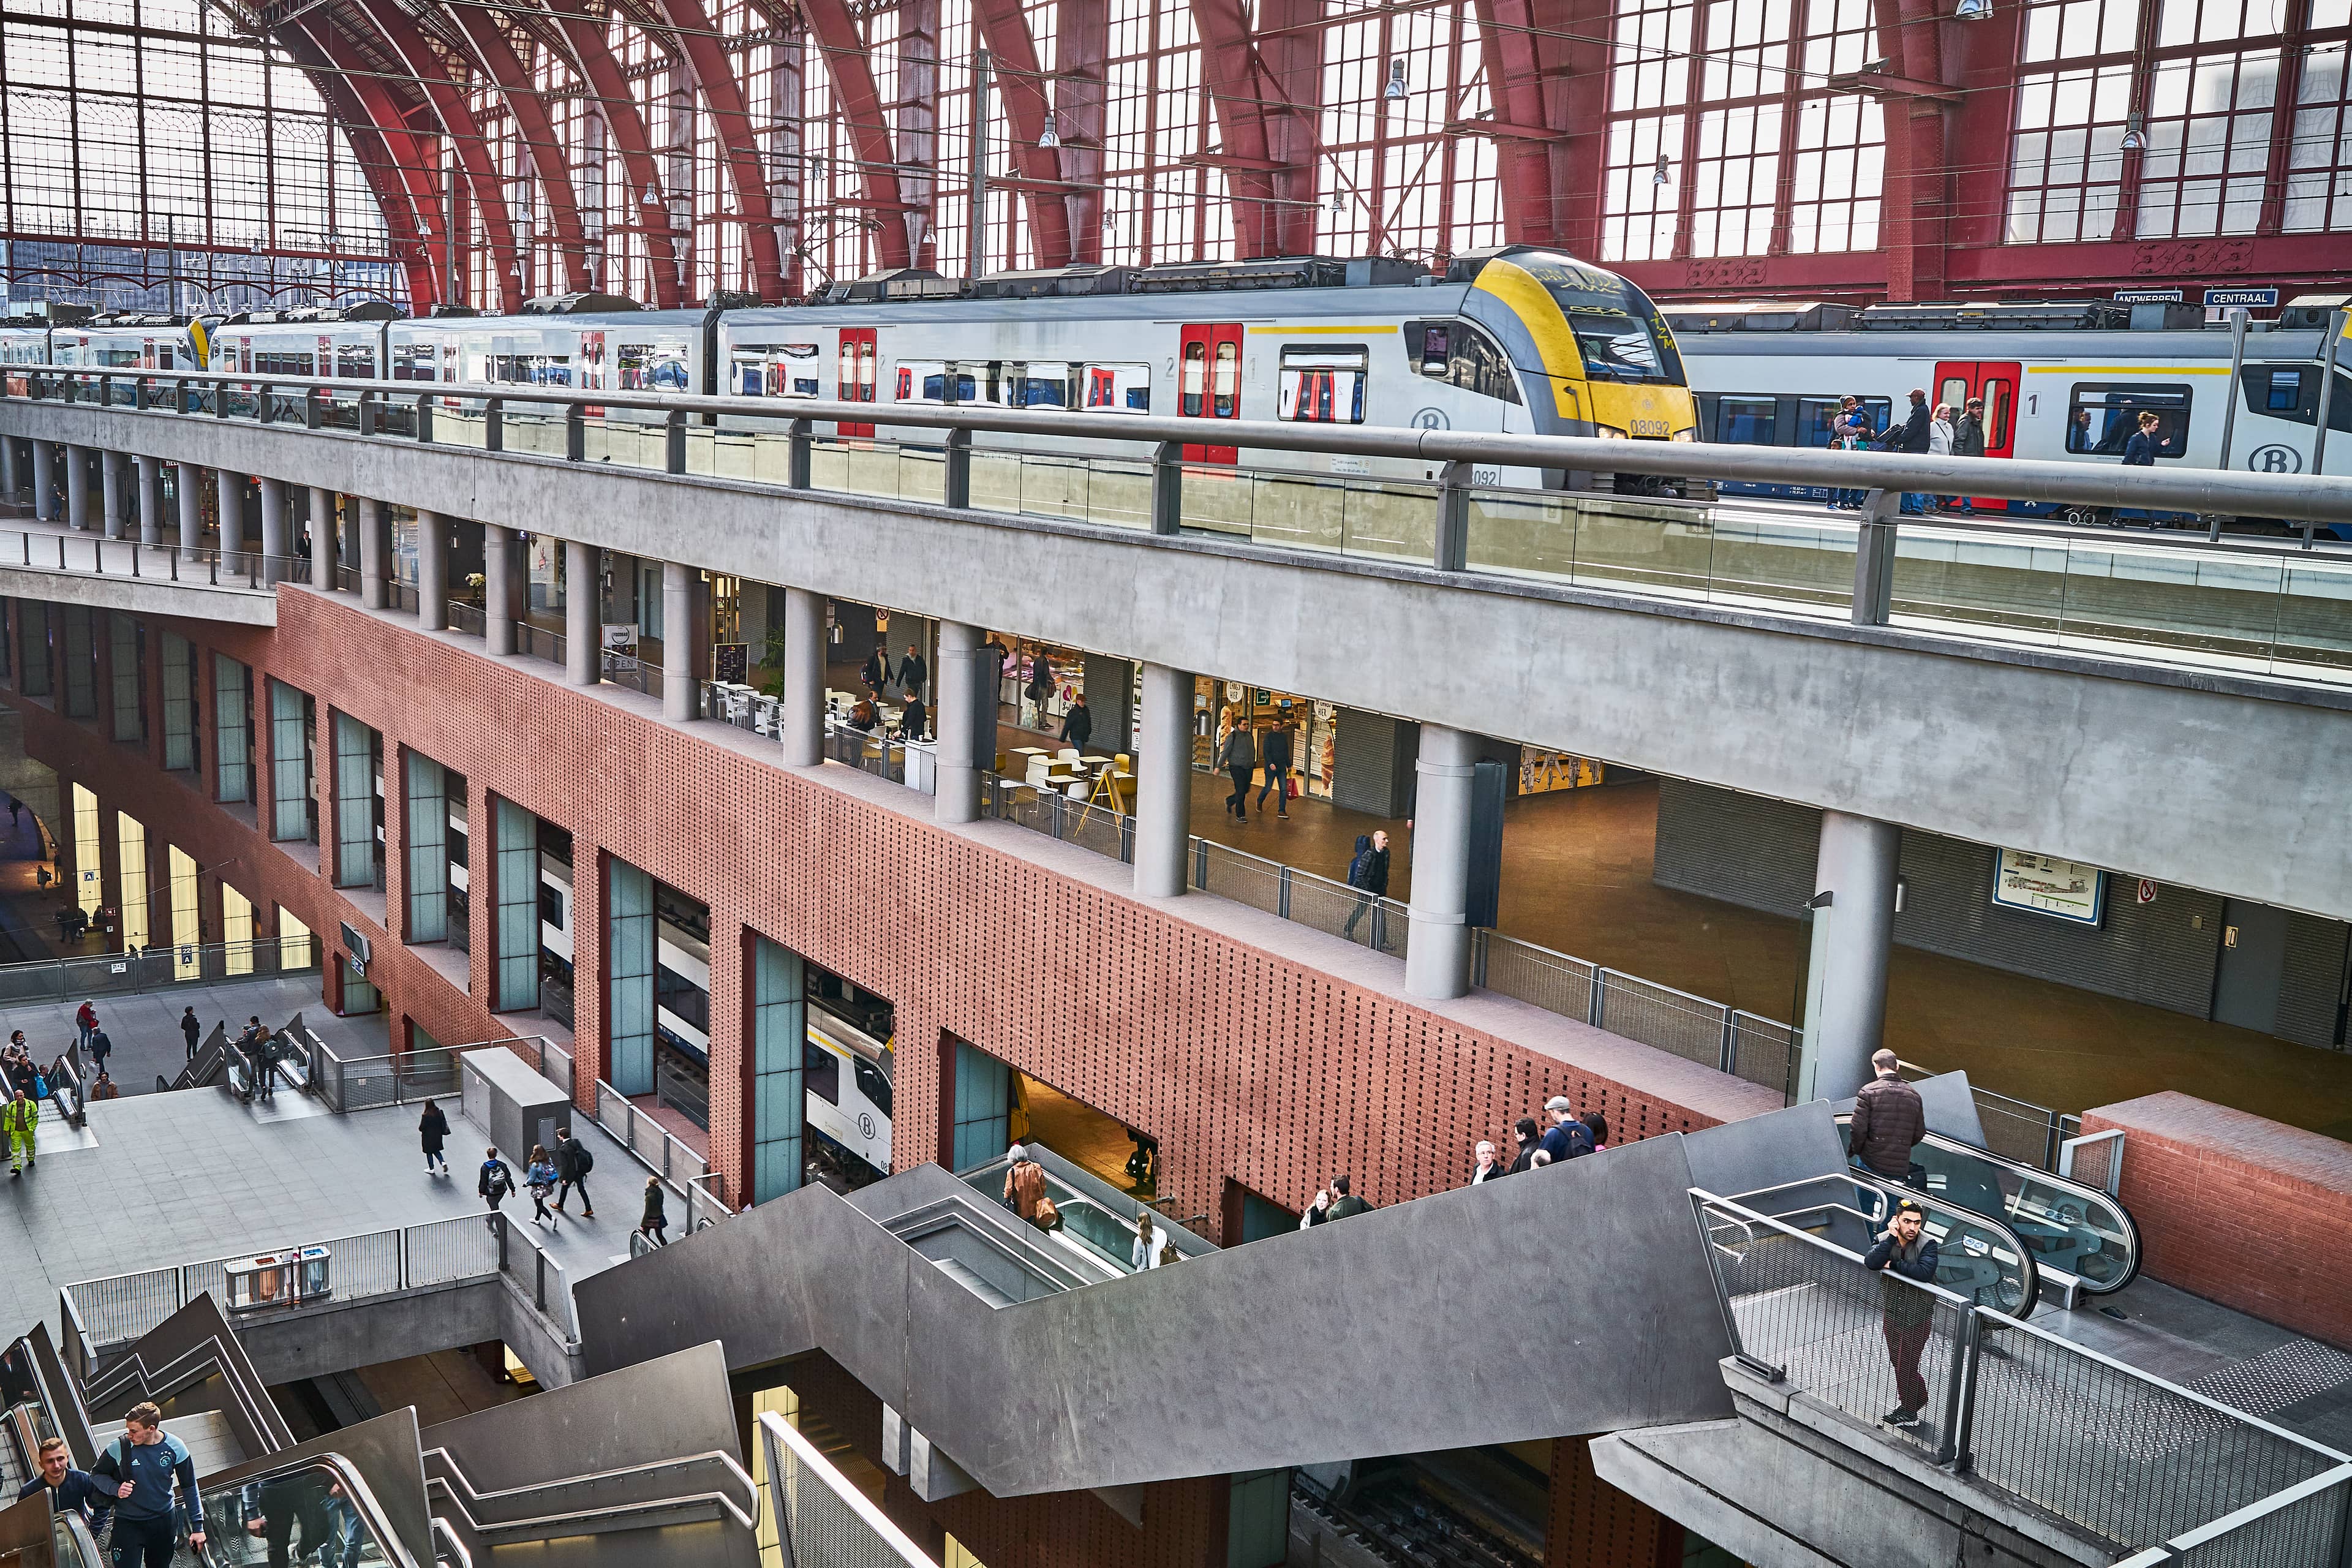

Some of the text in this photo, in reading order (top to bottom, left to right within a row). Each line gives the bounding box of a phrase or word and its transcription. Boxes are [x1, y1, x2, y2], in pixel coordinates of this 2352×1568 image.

[2212, 293, 2268, 304] CENTRAAL
[1166, 357, 1174, 378] 2
[1249, 357, 1256, 380] 1
[2028, 394, 2038, 415] 1
[1630, 419, 1670, 435] 08092
[1472, 470, 1496, 486] 092
